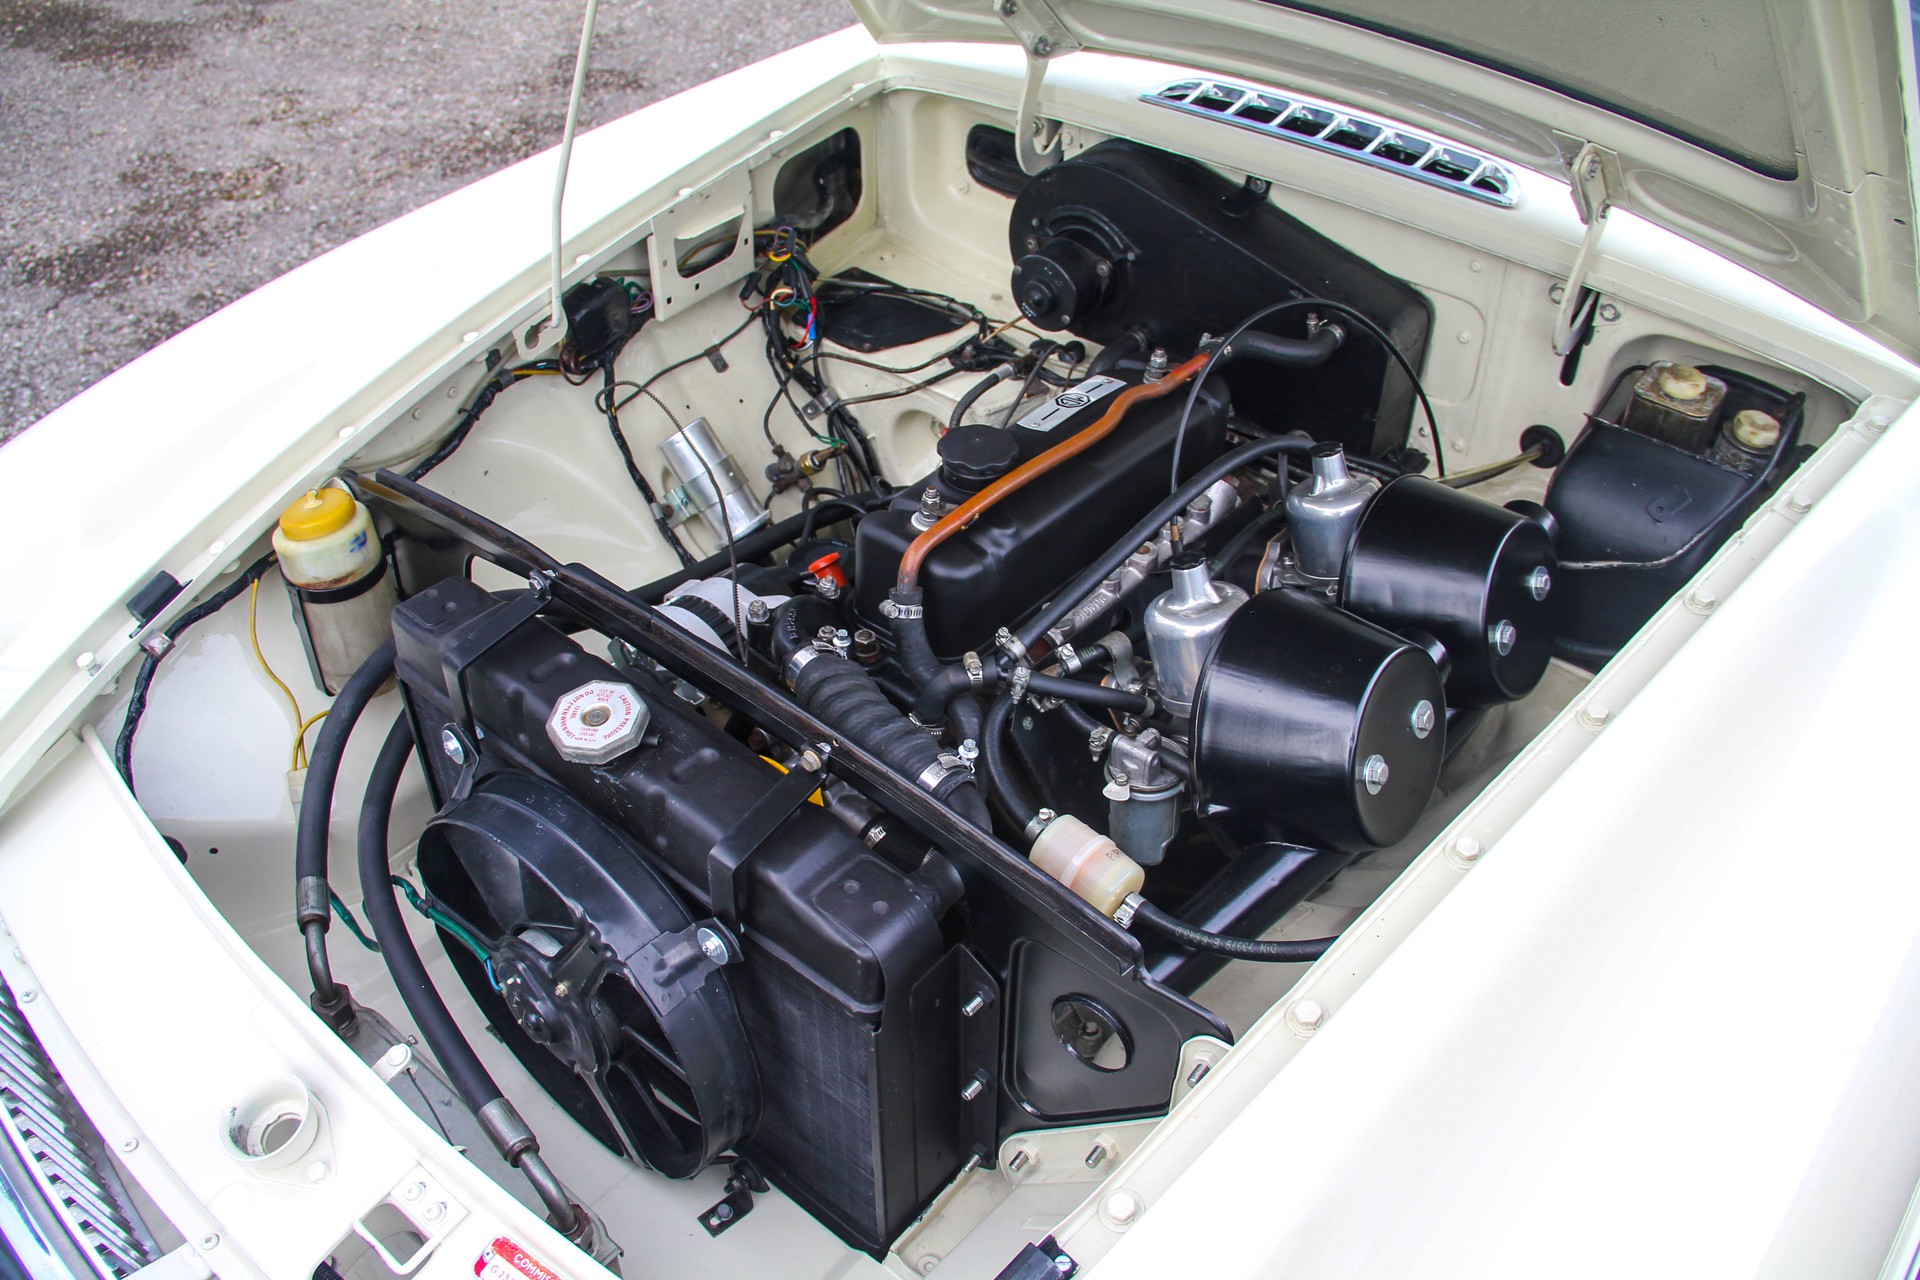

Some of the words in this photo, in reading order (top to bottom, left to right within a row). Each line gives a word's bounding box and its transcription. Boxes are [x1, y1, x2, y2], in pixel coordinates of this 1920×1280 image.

[1058, 394, 1086, 406] MG
[572, 694, 584, 702] NOT
[619, 694, 632, 715] CAUTION
[565, 730, 575, 738] HOT
[604, 718, 630, 739] PRESSURE
[1213, 938, 1221, 948] E
[1225, 940, 1254, 952] 73379
